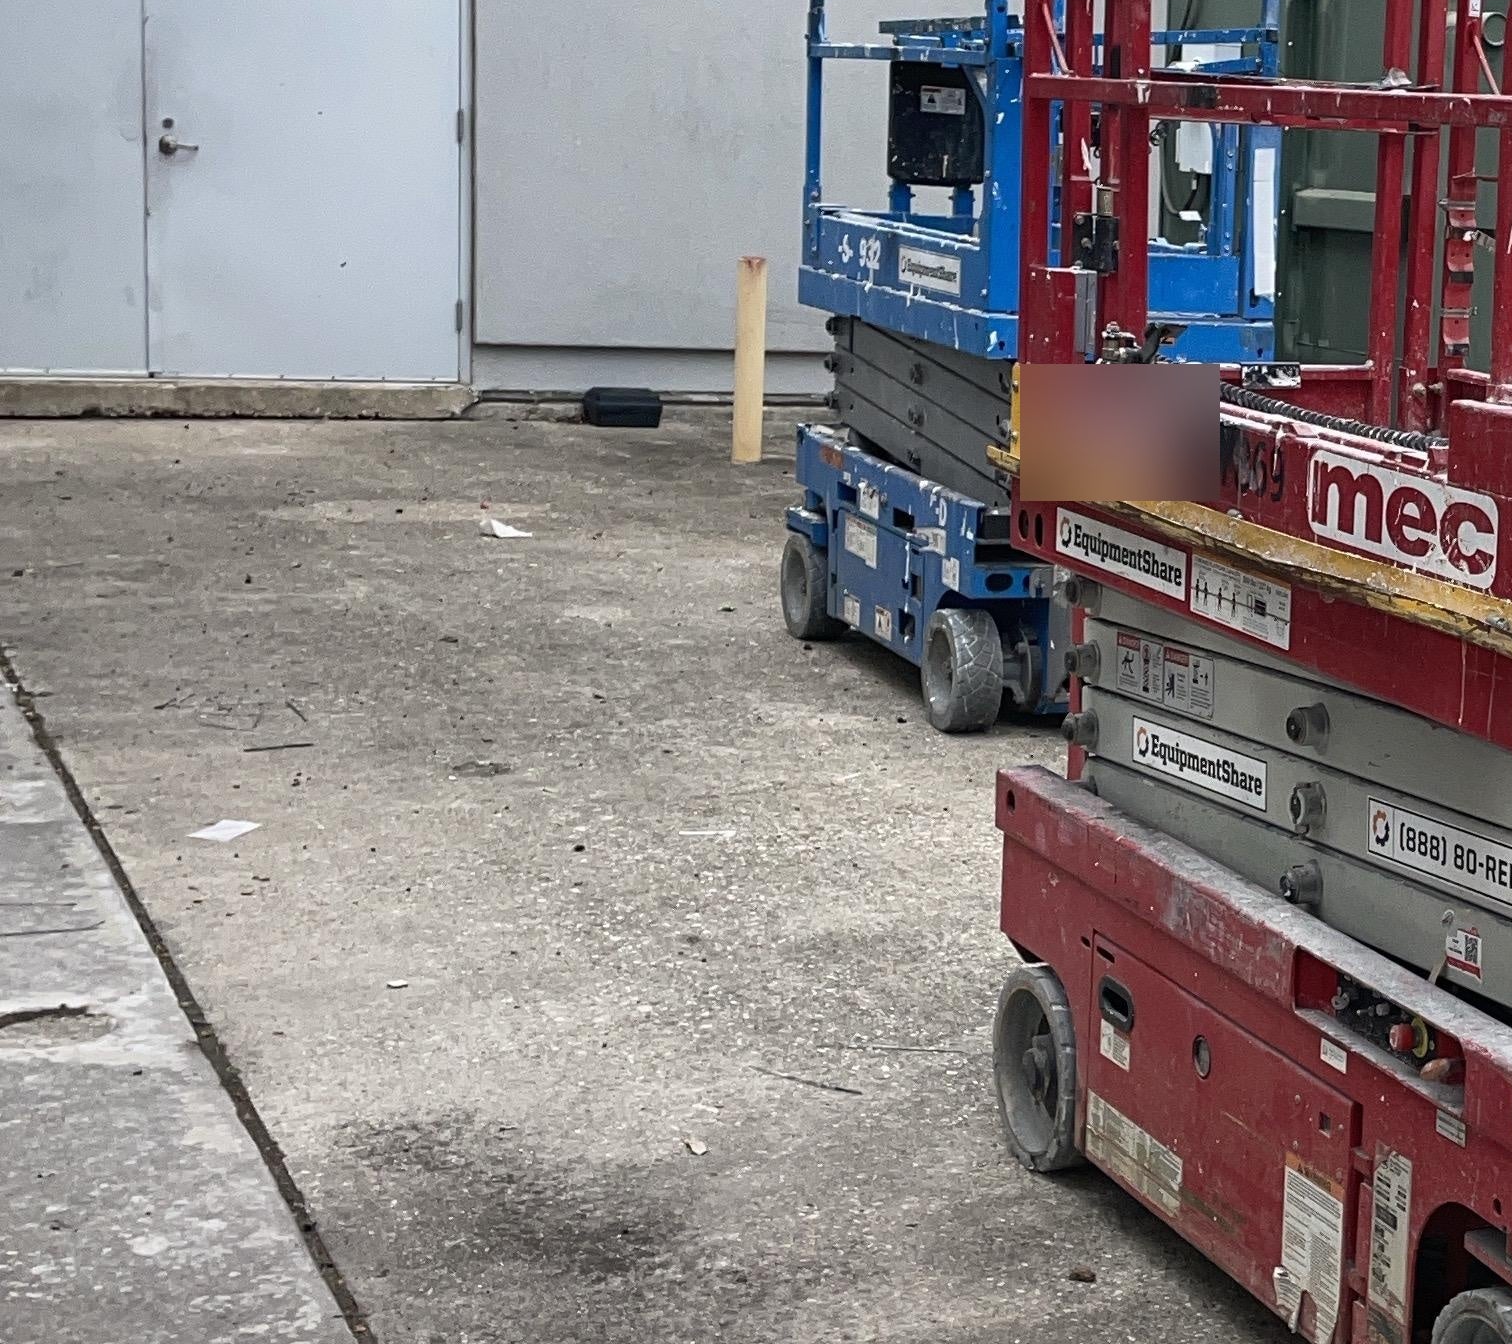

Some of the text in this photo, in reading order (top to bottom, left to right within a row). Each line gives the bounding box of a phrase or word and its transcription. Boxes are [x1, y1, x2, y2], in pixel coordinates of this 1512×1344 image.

[1311, 459, 1495, 575] mec
[1073, 523, 1183, 587] EquipmentShare
[1150, 733, 1263, 797] EquipmentShare
[1400, 822, 1447, 866] (888)
